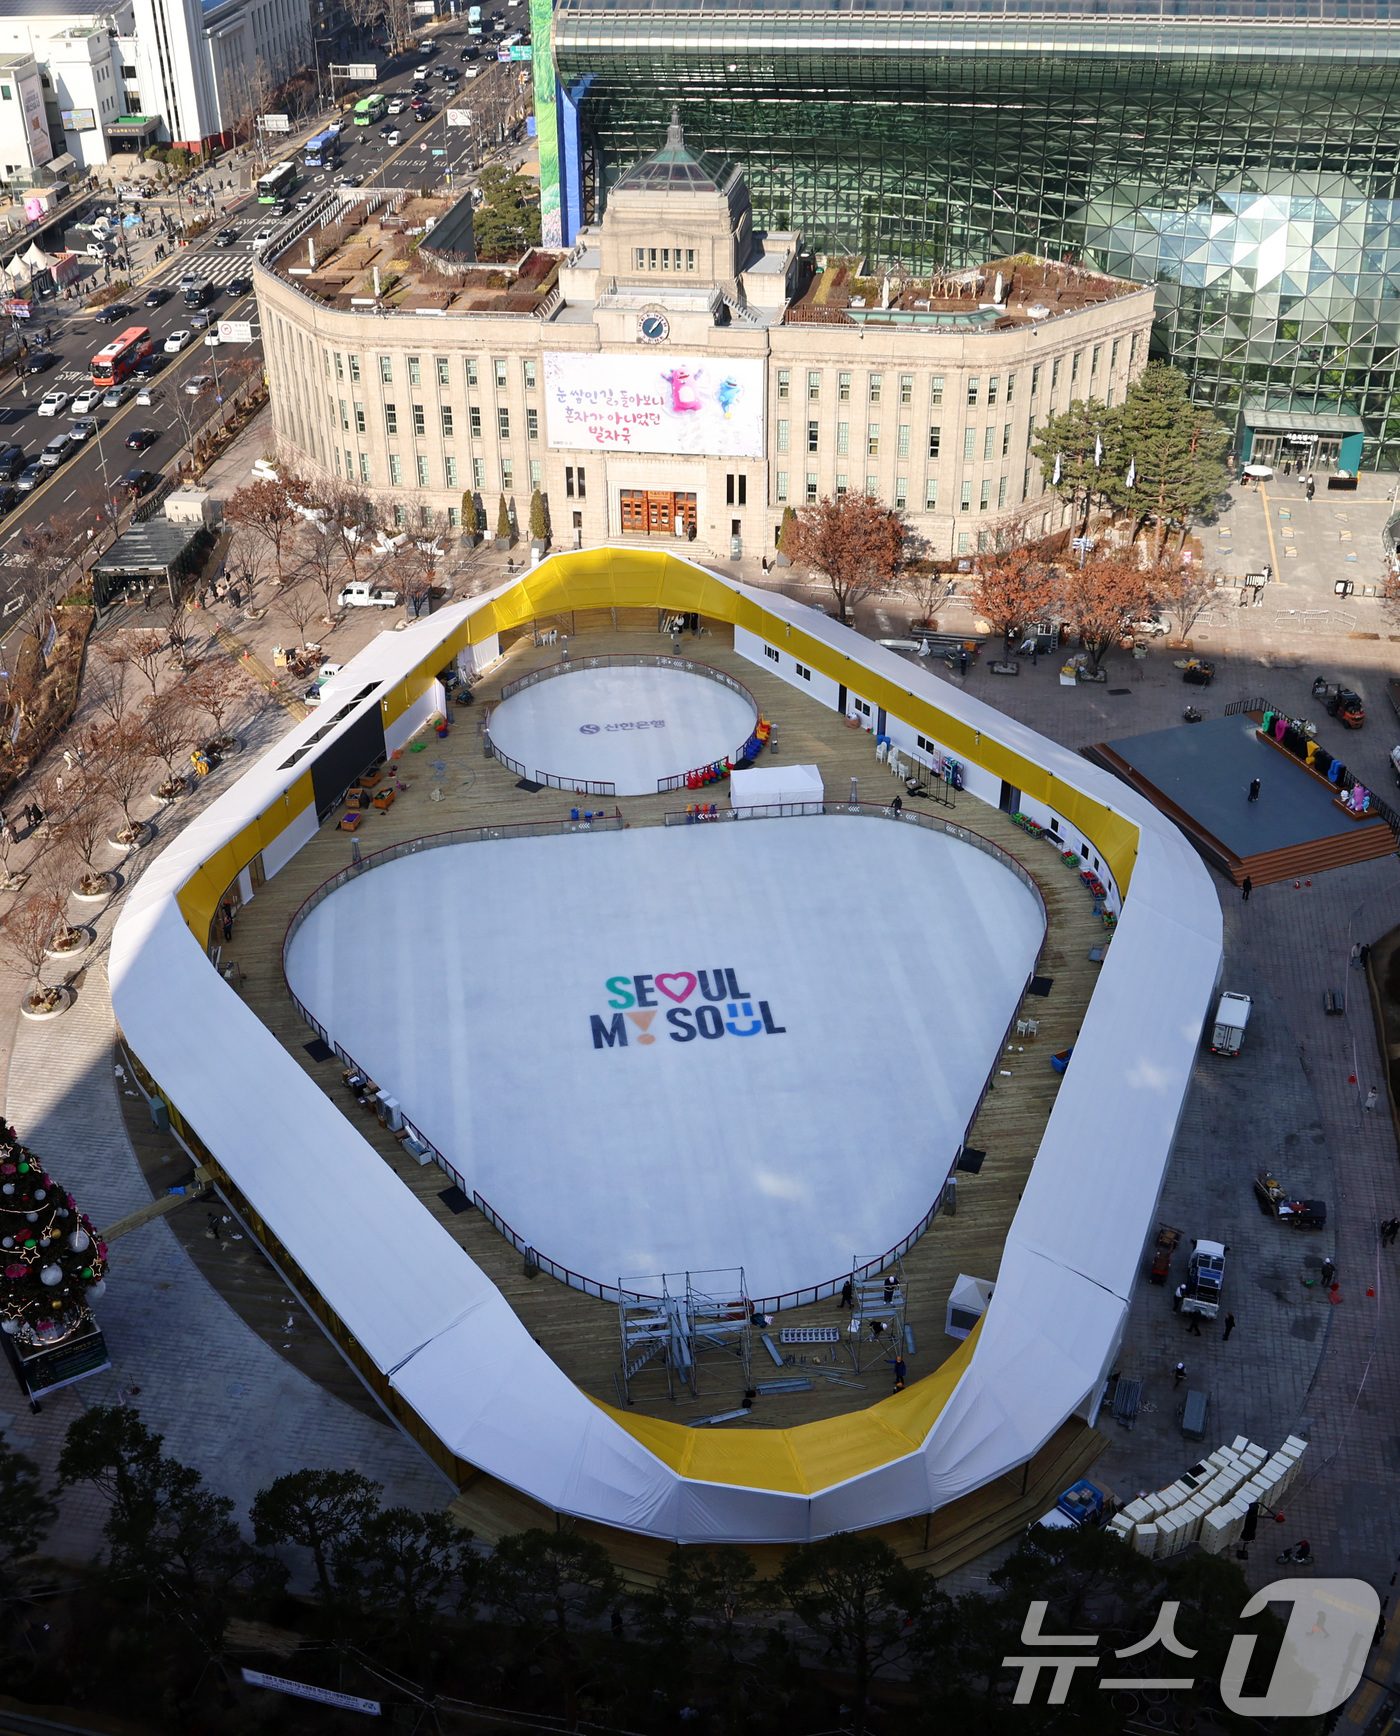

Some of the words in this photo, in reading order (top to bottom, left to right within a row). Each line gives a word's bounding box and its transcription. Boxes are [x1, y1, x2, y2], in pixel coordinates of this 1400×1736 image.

[556, 387, 567, 403] 눈
[570, 389, 598, 404] 쌓인
[600, 388, 619, 406] 길,
[620, 390, 665, 408] 돌아보니
[565, 405, 604, 424] 혼자가
[607, 411, 661, 427] 아니었던
[588, 426, 631, 444] 발자국
[604, 719, 666, 732] 신한은행
[665, 1000, 787, 1042] SOUL
